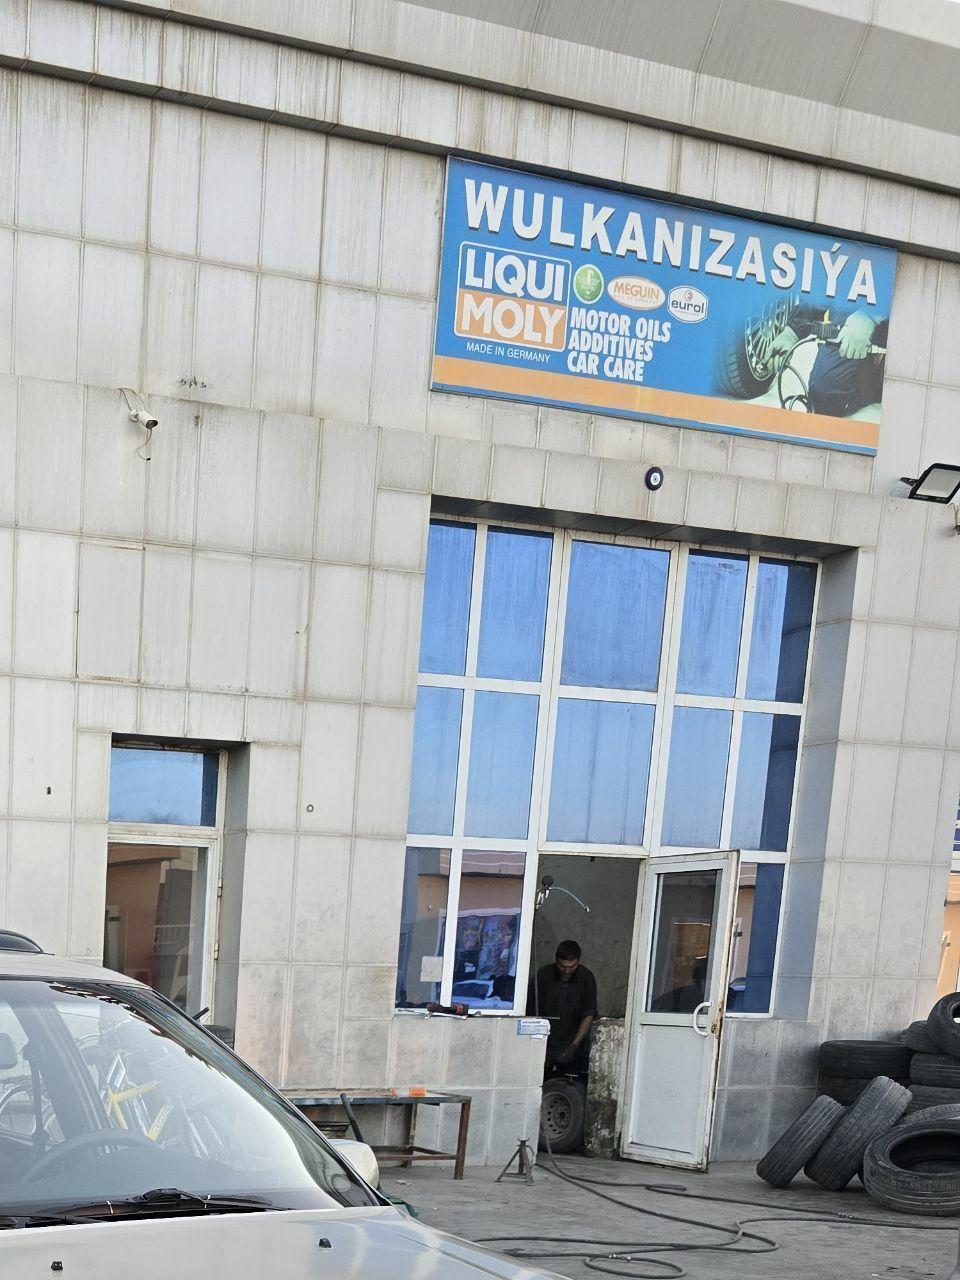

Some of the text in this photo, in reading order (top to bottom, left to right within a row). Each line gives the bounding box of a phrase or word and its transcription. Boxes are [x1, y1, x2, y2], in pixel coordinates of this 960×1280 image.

[464, 178, 877, 304] WULKANIZASIÝA
[465, 248, 565, 302] LIQUI
[461, 293, 565, 344] MOLY
[671, 299, 705, 314] eurol
[570, 306, 672, 342] MOTOR OILS
[466, 341, 551, 363] MADE IN GERMANY
[568, 329, 654, 361] ADDITIVES
[567, 351, 645, 382] CAR CARE
